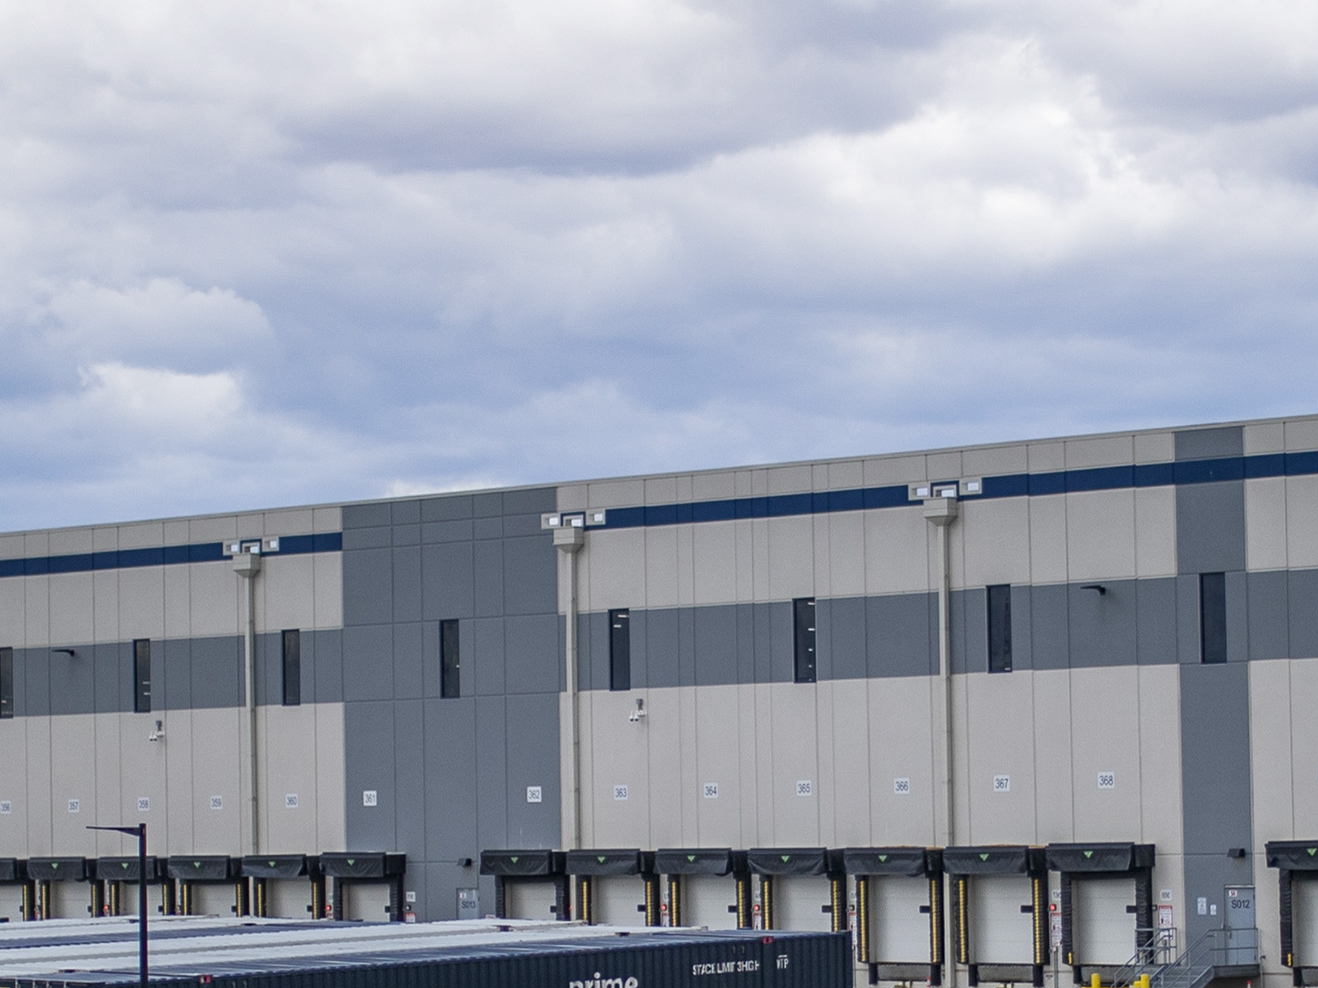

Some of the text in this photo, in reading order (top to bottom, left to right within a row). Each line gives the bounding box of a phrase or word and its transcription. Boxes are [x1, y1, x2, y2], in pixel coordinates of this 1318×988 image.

[995, 778, 1009, 789] 367
[1099, 775, 1114, 787] 368
[1231, 899, 1251, 909] S012
